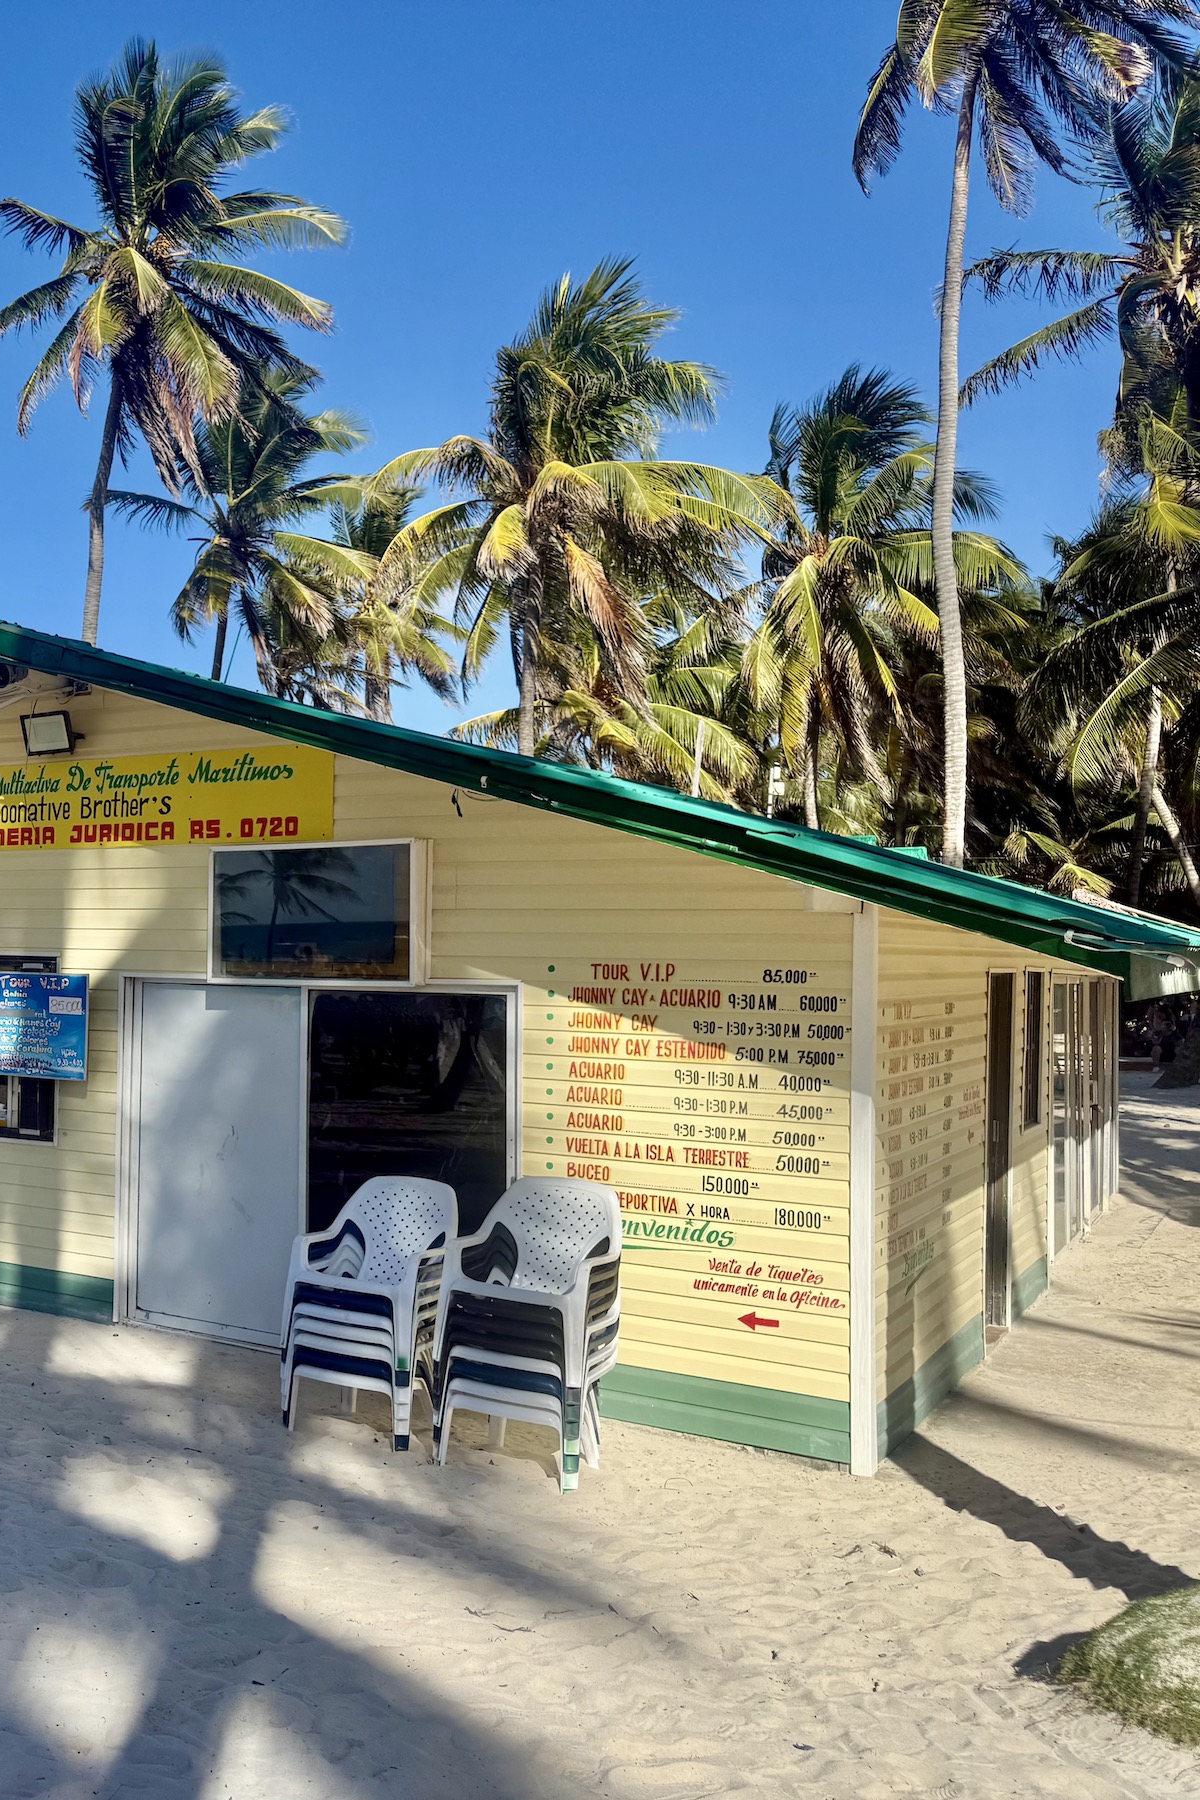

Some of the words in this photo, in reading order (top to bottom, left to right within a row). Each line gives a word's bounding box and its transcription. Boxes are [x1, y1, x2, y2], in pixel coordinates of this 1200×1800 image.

[66, 763, 92, 793] De
[95, 757, 180, 796] Transporte
[69, 821, 175, 843] JURIDICA
[240, 816, 299, 837] 0720
[590, 963, 630, 981] TOUR
[640, 963, 675, 982] V.I.P
[567, 986, 616, 1004] JHONNY
[622, 988, 648, 1006] CAY
[659, 988, 721, 1009] ACUARIO
[728, 993, 755, 1010] 9:30
[567, 1012, 623, 1030] JHONNY
[631, 1014, 658, 1032] CAY
[567, 1036, 620, 1054] JHONNY
[625, 1038, 651, 1056] CAY
[656, 1040, 726, 1060] ESTENDIDO
[735, 1047, 764, 1062] 5:00
[568, 1061, 625, 1080] ACUARIO
[566, 1085, 623, 1106] ACUARIO
[566, 1111, 623, 1132] ACUARIO
[565, 1137, 608, 1156] VUELTA
[614, 1141, 621, 1157] A
[625, 1142, 640, 1159] LA
[646, 1144, 674, 1162] ISLA
[683, 1147, 750, 1169] TERRESTRE
[566, 1162, 610, 1182] BUCEO
[686, 1203, 695, 1217] X
[700, 1205, 730, 1220] HORA
[745, 1261, 762, 1277] de
[693, 1277, 759, 1298] unicamente
[762, 1289, 774, 1301] en
[776, 1287, 787, 1302] la
